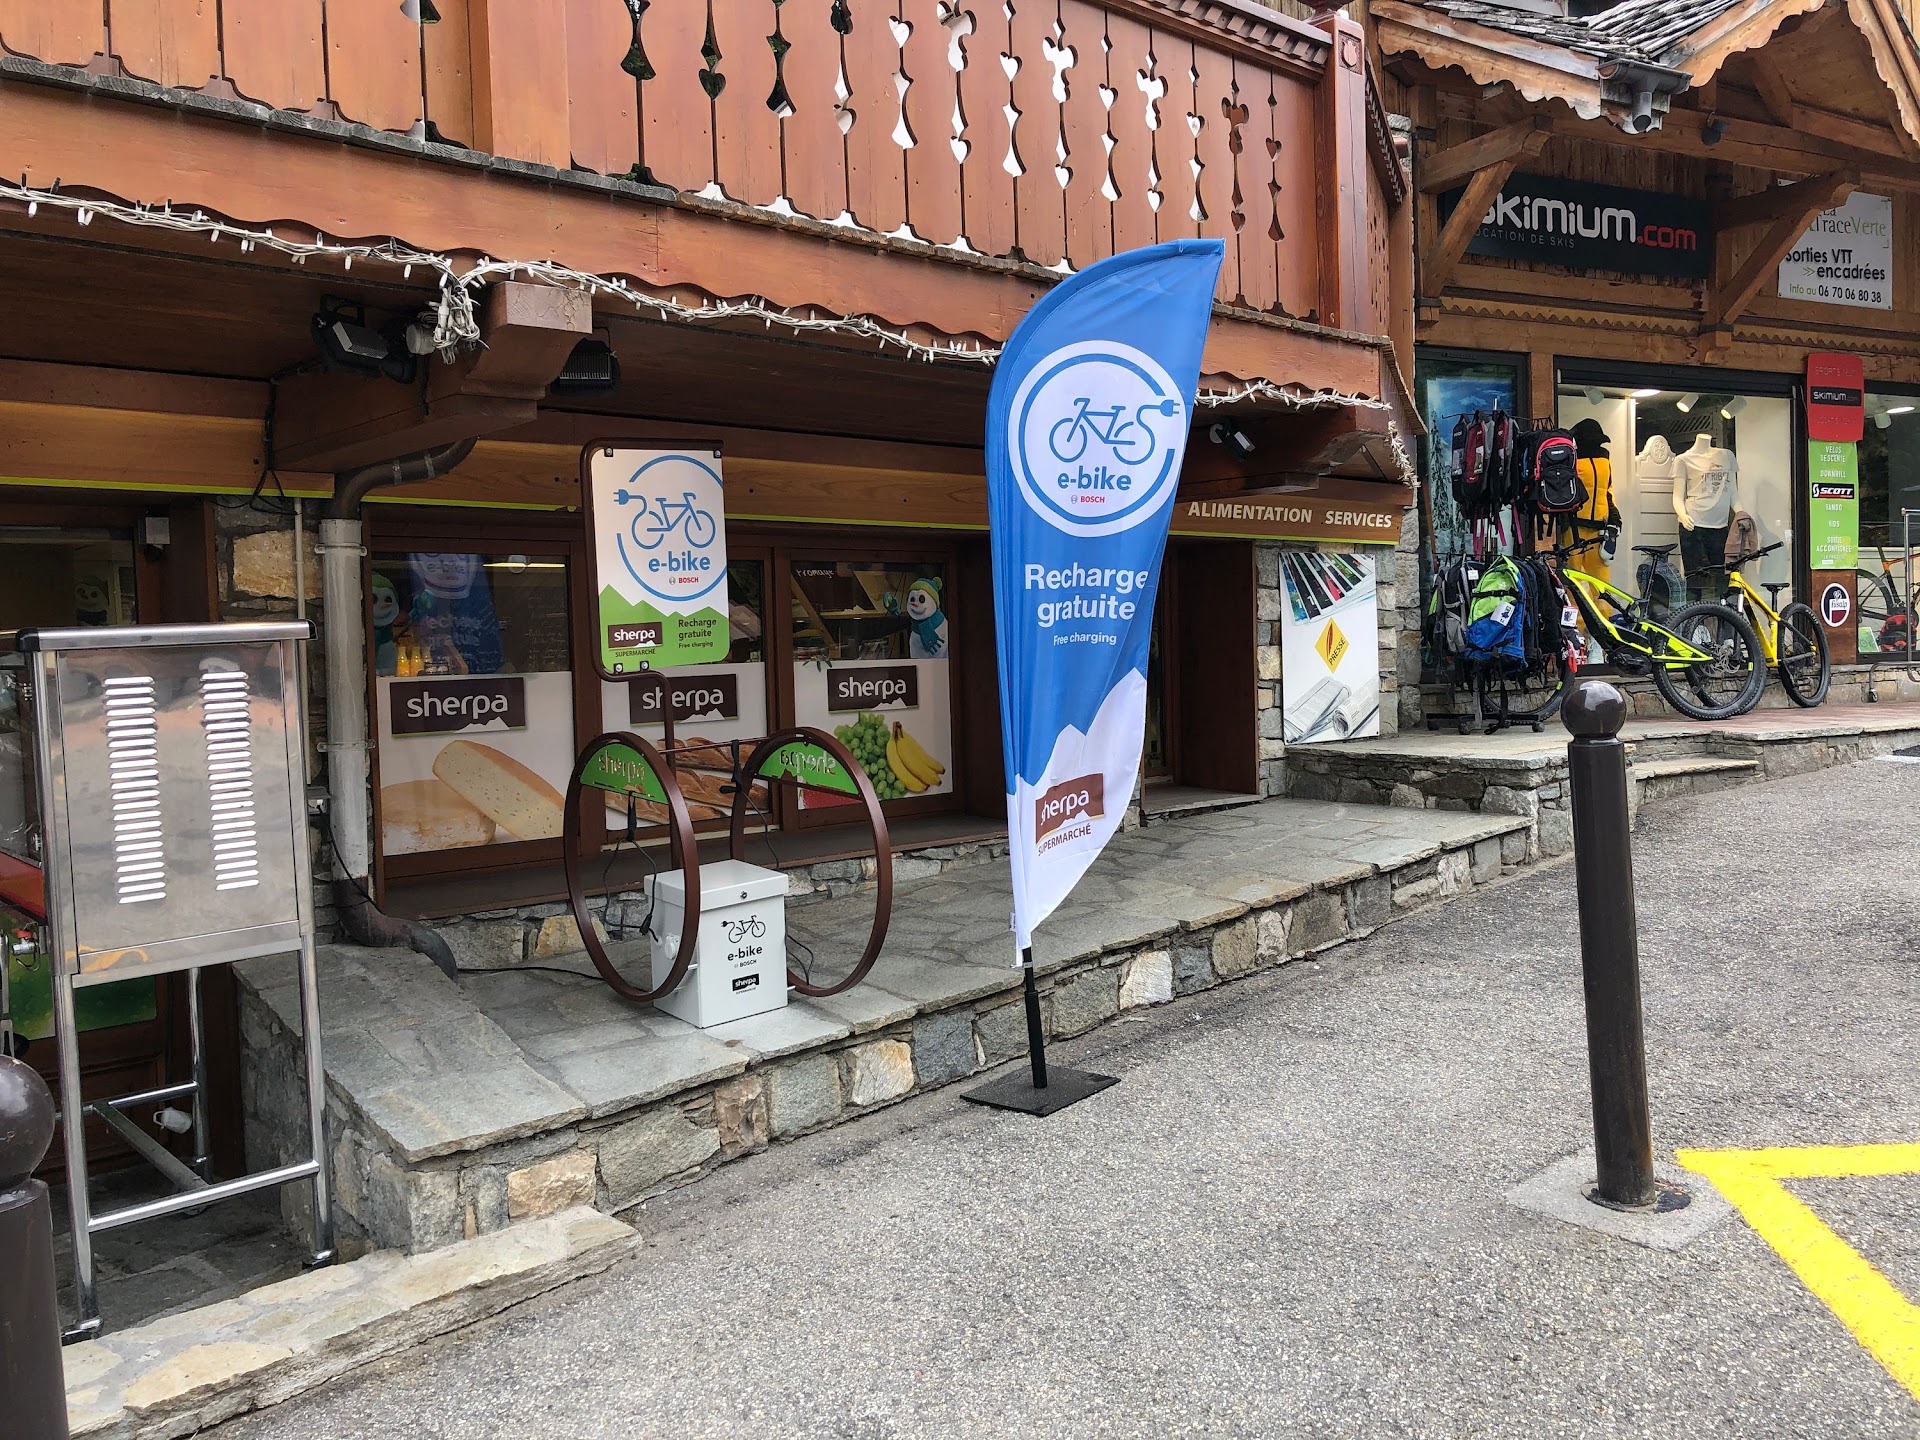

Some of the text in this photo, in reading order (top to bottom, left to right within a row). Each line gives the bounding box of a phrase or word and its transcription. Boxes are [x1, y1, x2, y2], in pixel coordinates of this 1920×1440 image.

[1530, 234, 1544, 244] DE
[1550, 236, 1575, 249] SKIS
[1832, 249, 1852, 264] VTT
[1817, 263, 1886, 281] encadrées
[1789, 284, 1882, 303] Info au 06 70 06 80 38
[1057, 465, 1131, 491] e-bike
[1080, 495, 1105, 503] BOSCH
[1820, 487, 1853, 495] SCOTT
[1187, 501, 1393, 529] ALIMENTATION SERVICES
[648, 550, 711, 572] e-bike
[1025, 562, 1149, 594] Recharge
[1037, 593, 1136, 628] gratuite
[678, 618, 717, 628] Recharge
[614, 628, 656, 642] sherpa
[678, 629, 712, 641] gratuite
[1053, 632, 1117, 646] Free charging
[1328, 637, 1347, 666] PRESSE
[838, 676, 907, 700] sherpa
[407, 691, 508, 719] sherpa
[598, 750, 646, 783] sherpa
[727, 945, 763, 961] e-bike
[739, 959, 757, 968] BOSCH
[735, 977, 757, 988] sherpa
